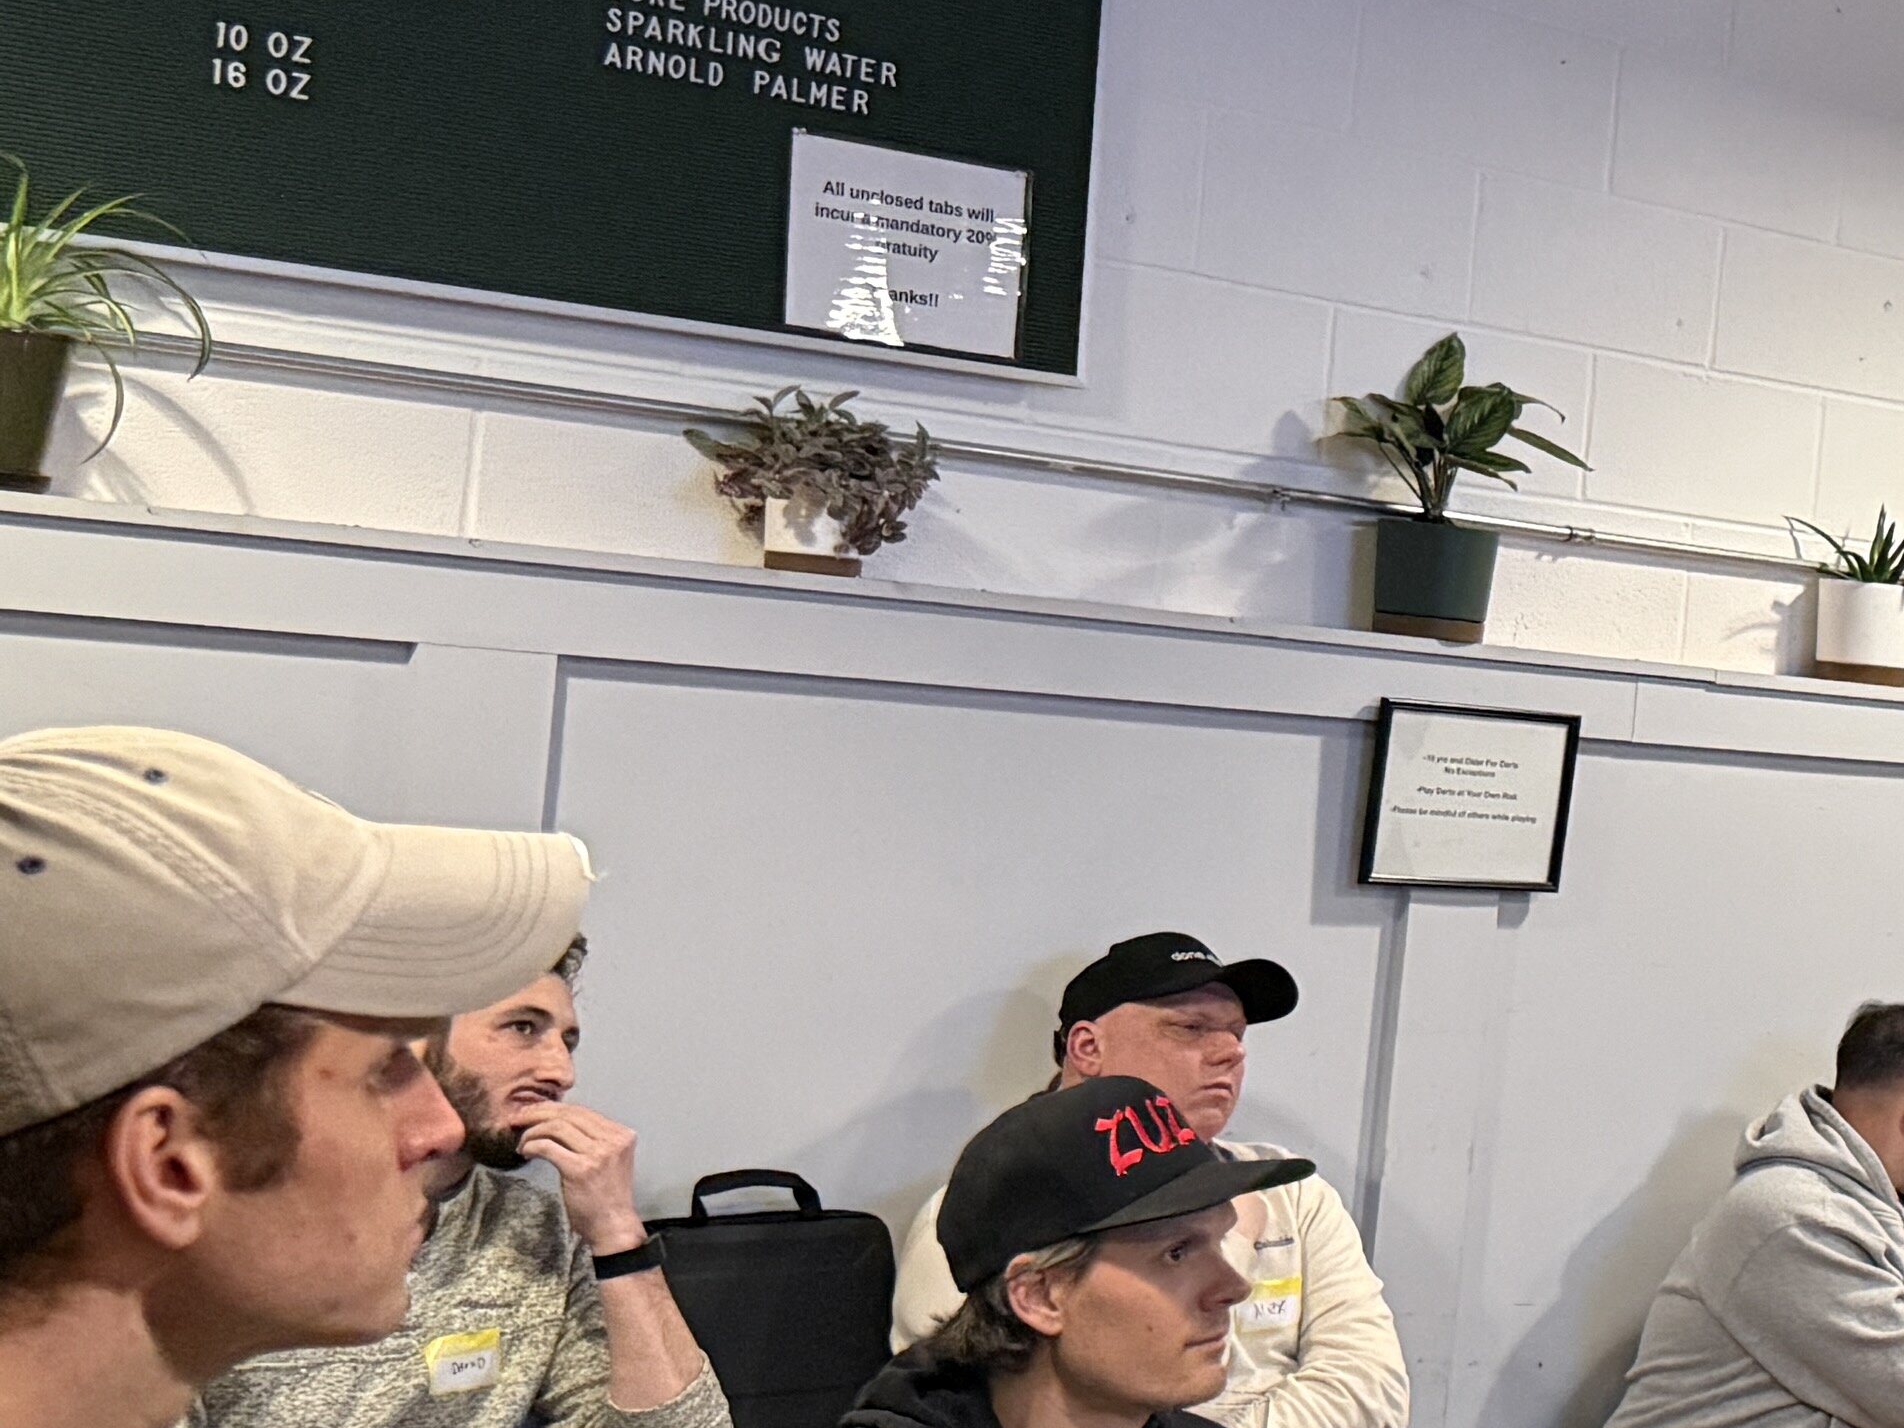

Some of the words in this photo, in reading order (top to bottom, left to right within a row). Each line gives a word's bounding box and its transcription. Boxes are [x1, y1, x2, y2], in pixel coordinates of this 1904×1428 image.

[215, 22, 249, 51] 10
[267, 32, 314, 64] OZ
[606, 8, 782, 65] SPARKLING
[804, 46, 899, 87] WATER
[211, 58, 247, 88] 16
[265, 69, 311, 100] OZ
[603, 42, 725, 88] ARNOLD
[753, 70, 870, 115] PALMER
[823, 180, 845, 198] All
[850, 186, 924, 211] unclosed
[929, 200, 963, 218] tabs
[967, 205, 995, 223] will
[875, 215, 962, 245] mandatory
[888, 287, 939, 308] anks!!
